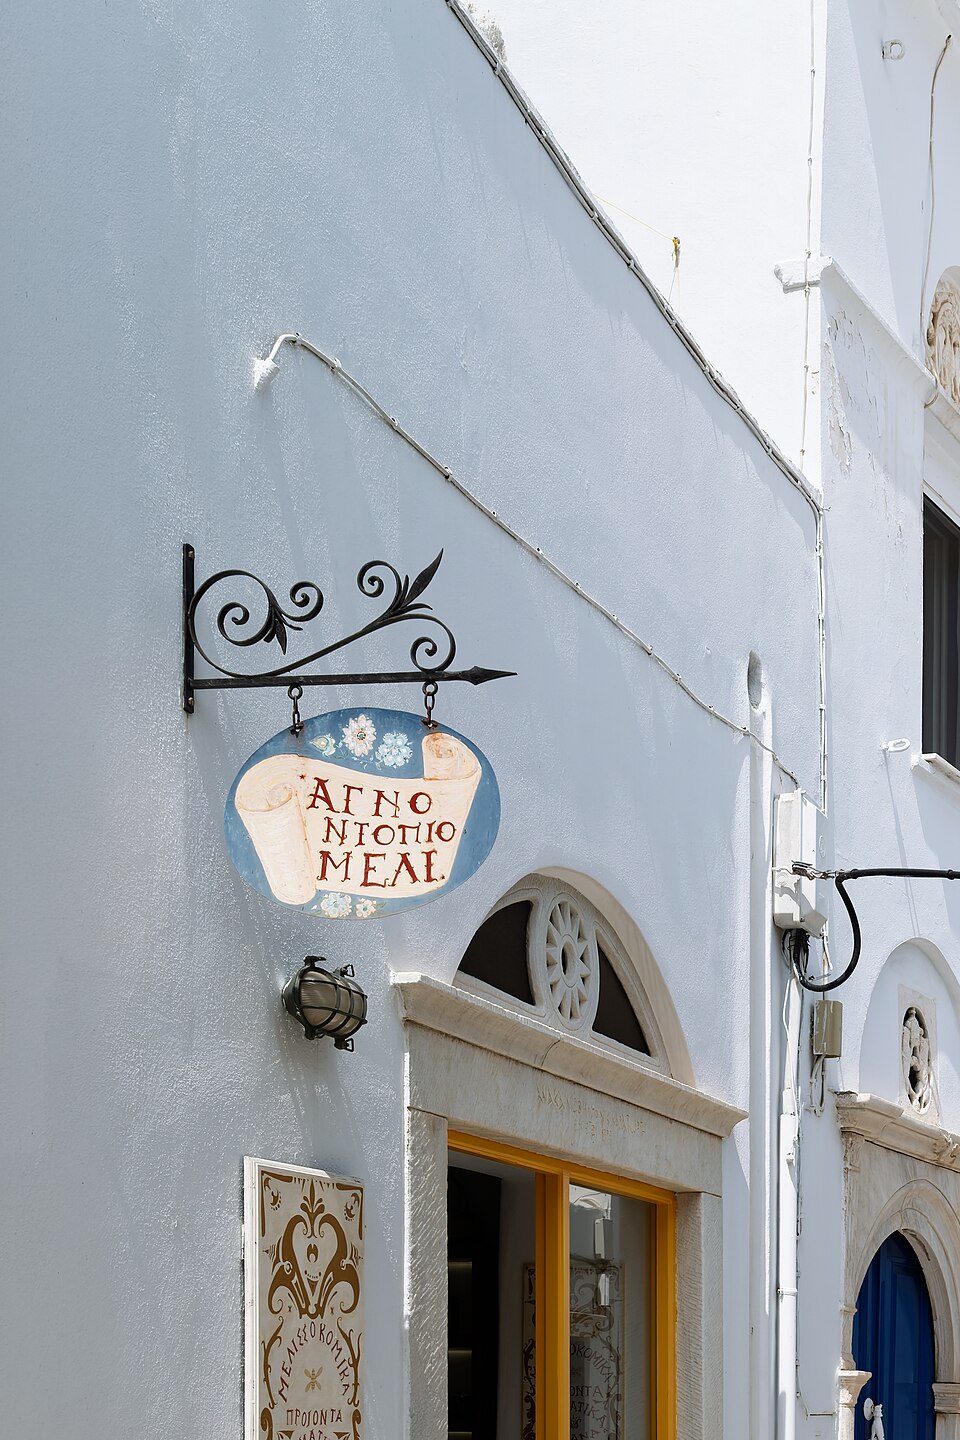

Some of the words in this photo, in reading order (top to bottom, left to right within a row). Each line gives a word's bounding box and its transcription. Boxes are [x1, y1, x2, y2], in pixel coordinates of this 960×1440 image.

[306, 777, 432, 818] ΑΓΝΟ
[322, 816, 457, 847] ΝΤΟΠΙΟ
[316, 848, 438, 888] ΜΕΛΙ
[278, 1321, 350, 1403] ΜΕΛΙΣΣΟΚΟΜΙΚΑ
